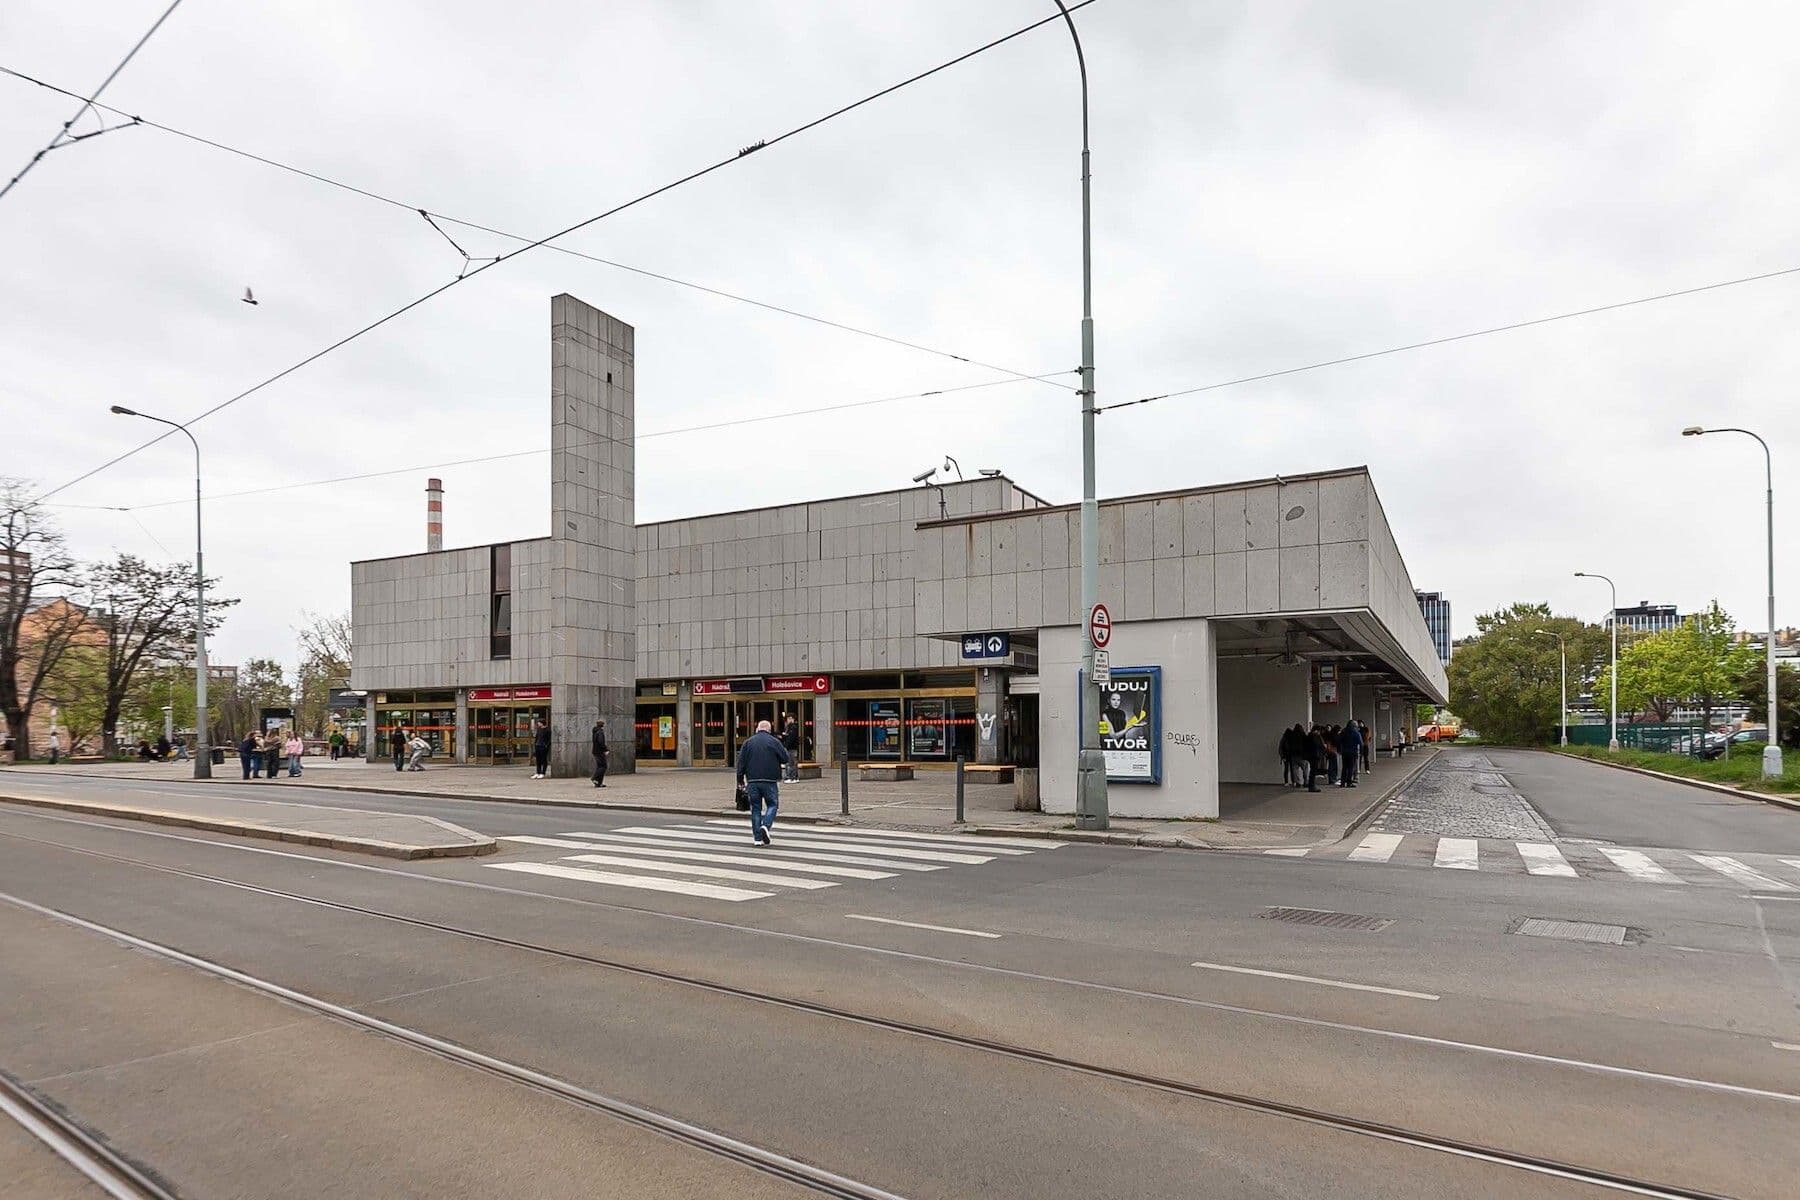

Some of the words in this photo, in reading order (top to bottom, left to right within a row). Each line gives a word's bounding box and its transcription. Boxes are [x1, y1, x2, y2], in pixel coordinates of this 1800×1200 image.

[816, 678, 825, 689] C
[1099, 682, 1148, 691] TUDUJ
[1103, 736, 1148, 749] TVOŘ
